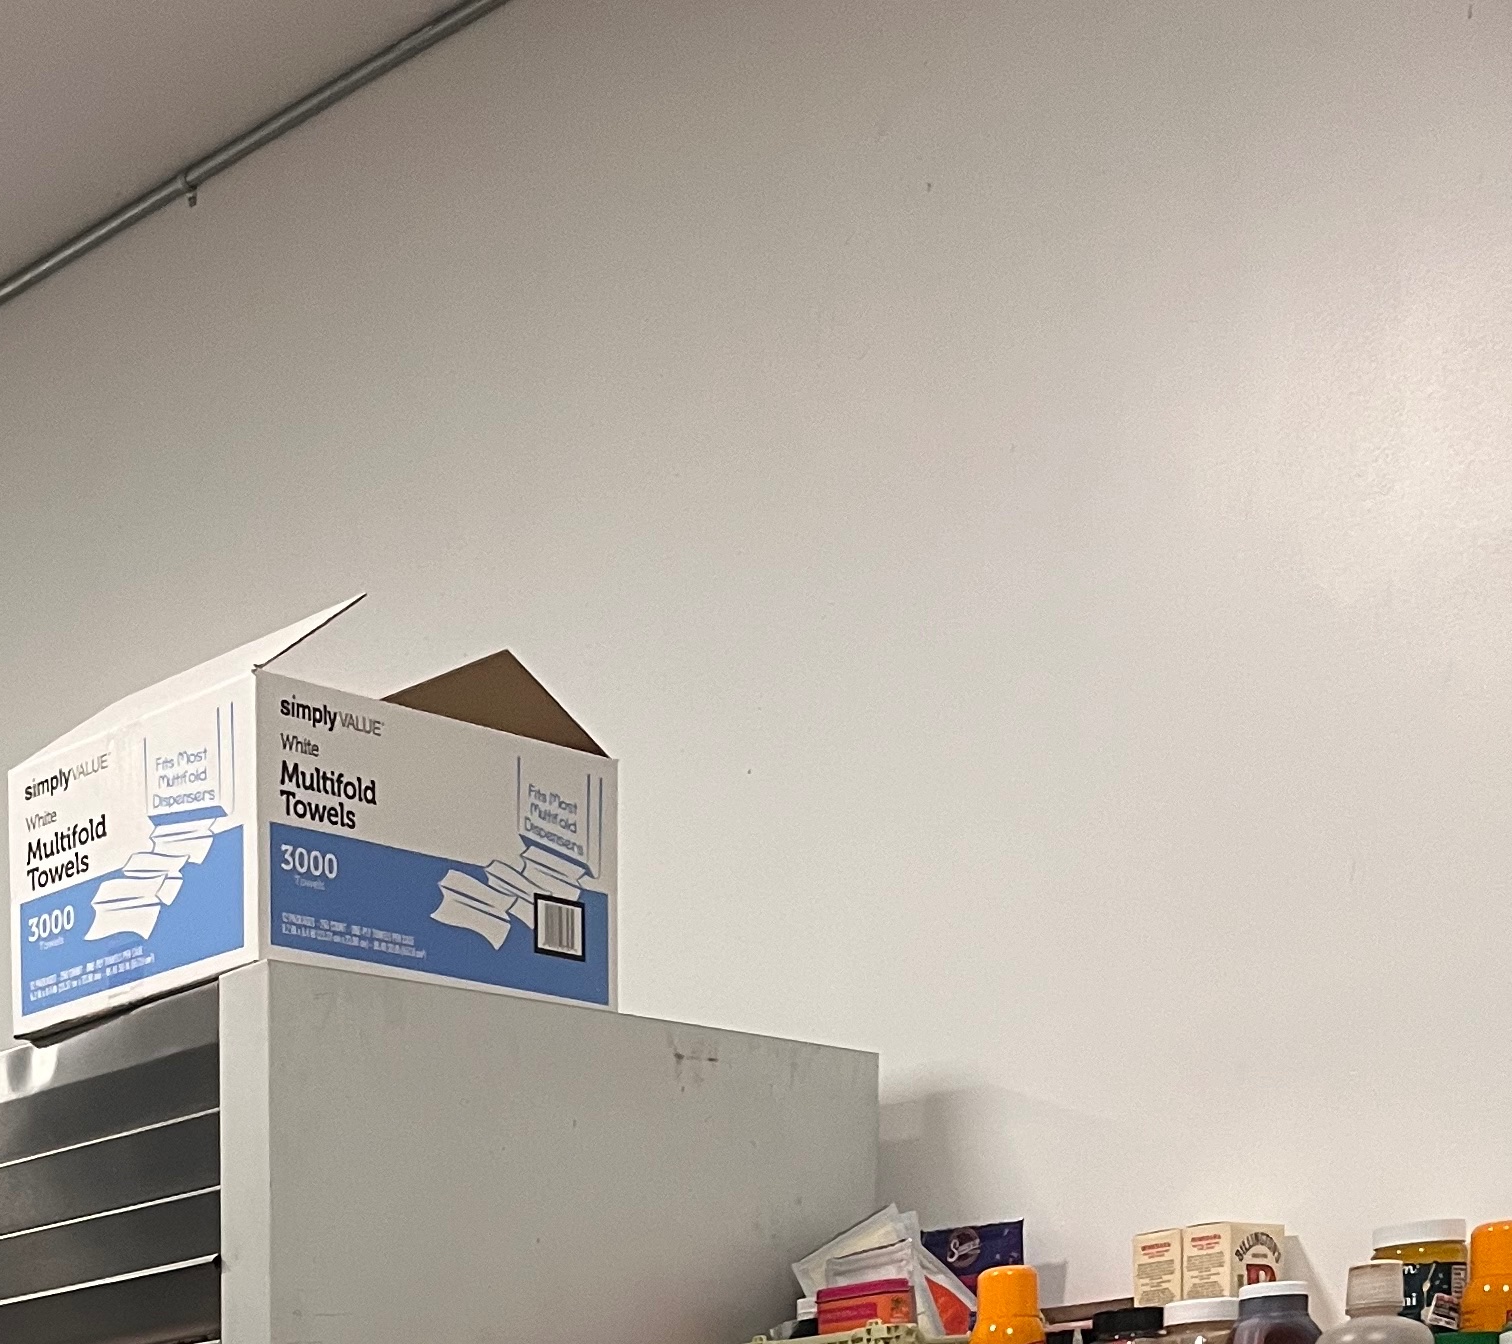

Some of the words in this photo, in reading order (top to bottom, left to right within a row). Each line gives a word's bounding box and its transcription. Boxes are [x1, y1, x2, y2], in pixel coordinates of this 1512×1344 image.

[156, 755, 176, 771] Fits
[176, 747, 208, 768] Most
[280, 733, 319, 757] White
[158, 767, 208, 789] Multifold
[280, 759, 377, 805] Multifold
[152, 788, 215, 809] Dispensers
[280, 789, 357, 829] Towels
[527, 783, 548, 804] Fits
[548, 790, 578, 815] Most
[25, 809, 57, 832] White
[530, 802, 578, 833] Multifold
[26, 813, 108, 866] Multifold
[524, 816, 584, 856] Dispensers
[27, 852, 90, 891] Towels
[280, 844, 338, 879] 3000
[28, 905, 75, 943] 3000
